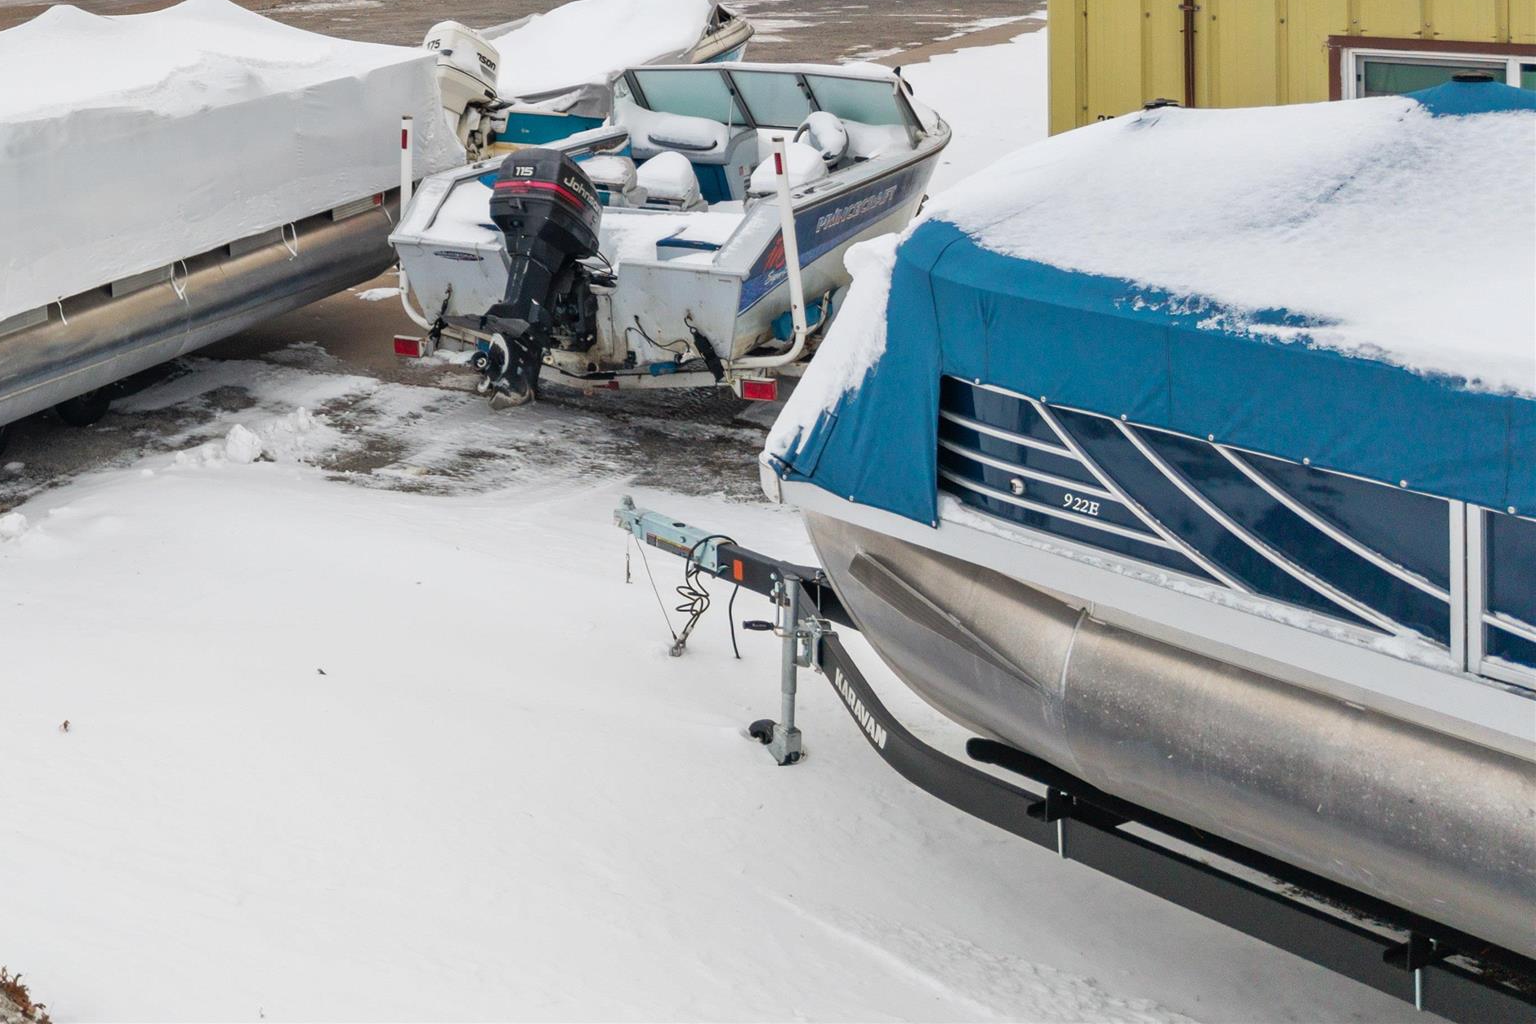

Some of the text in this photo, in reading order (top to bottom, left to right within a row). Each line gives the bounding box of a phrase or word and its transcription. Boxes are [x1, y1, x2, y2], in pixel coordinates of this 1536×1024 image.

[515, 166, 534, 177] 115
[563, 176, 602, 216] Johnson
[1063, 493, 1100, 516] 922E
[834, 667, 887, 750] KARAVAN
